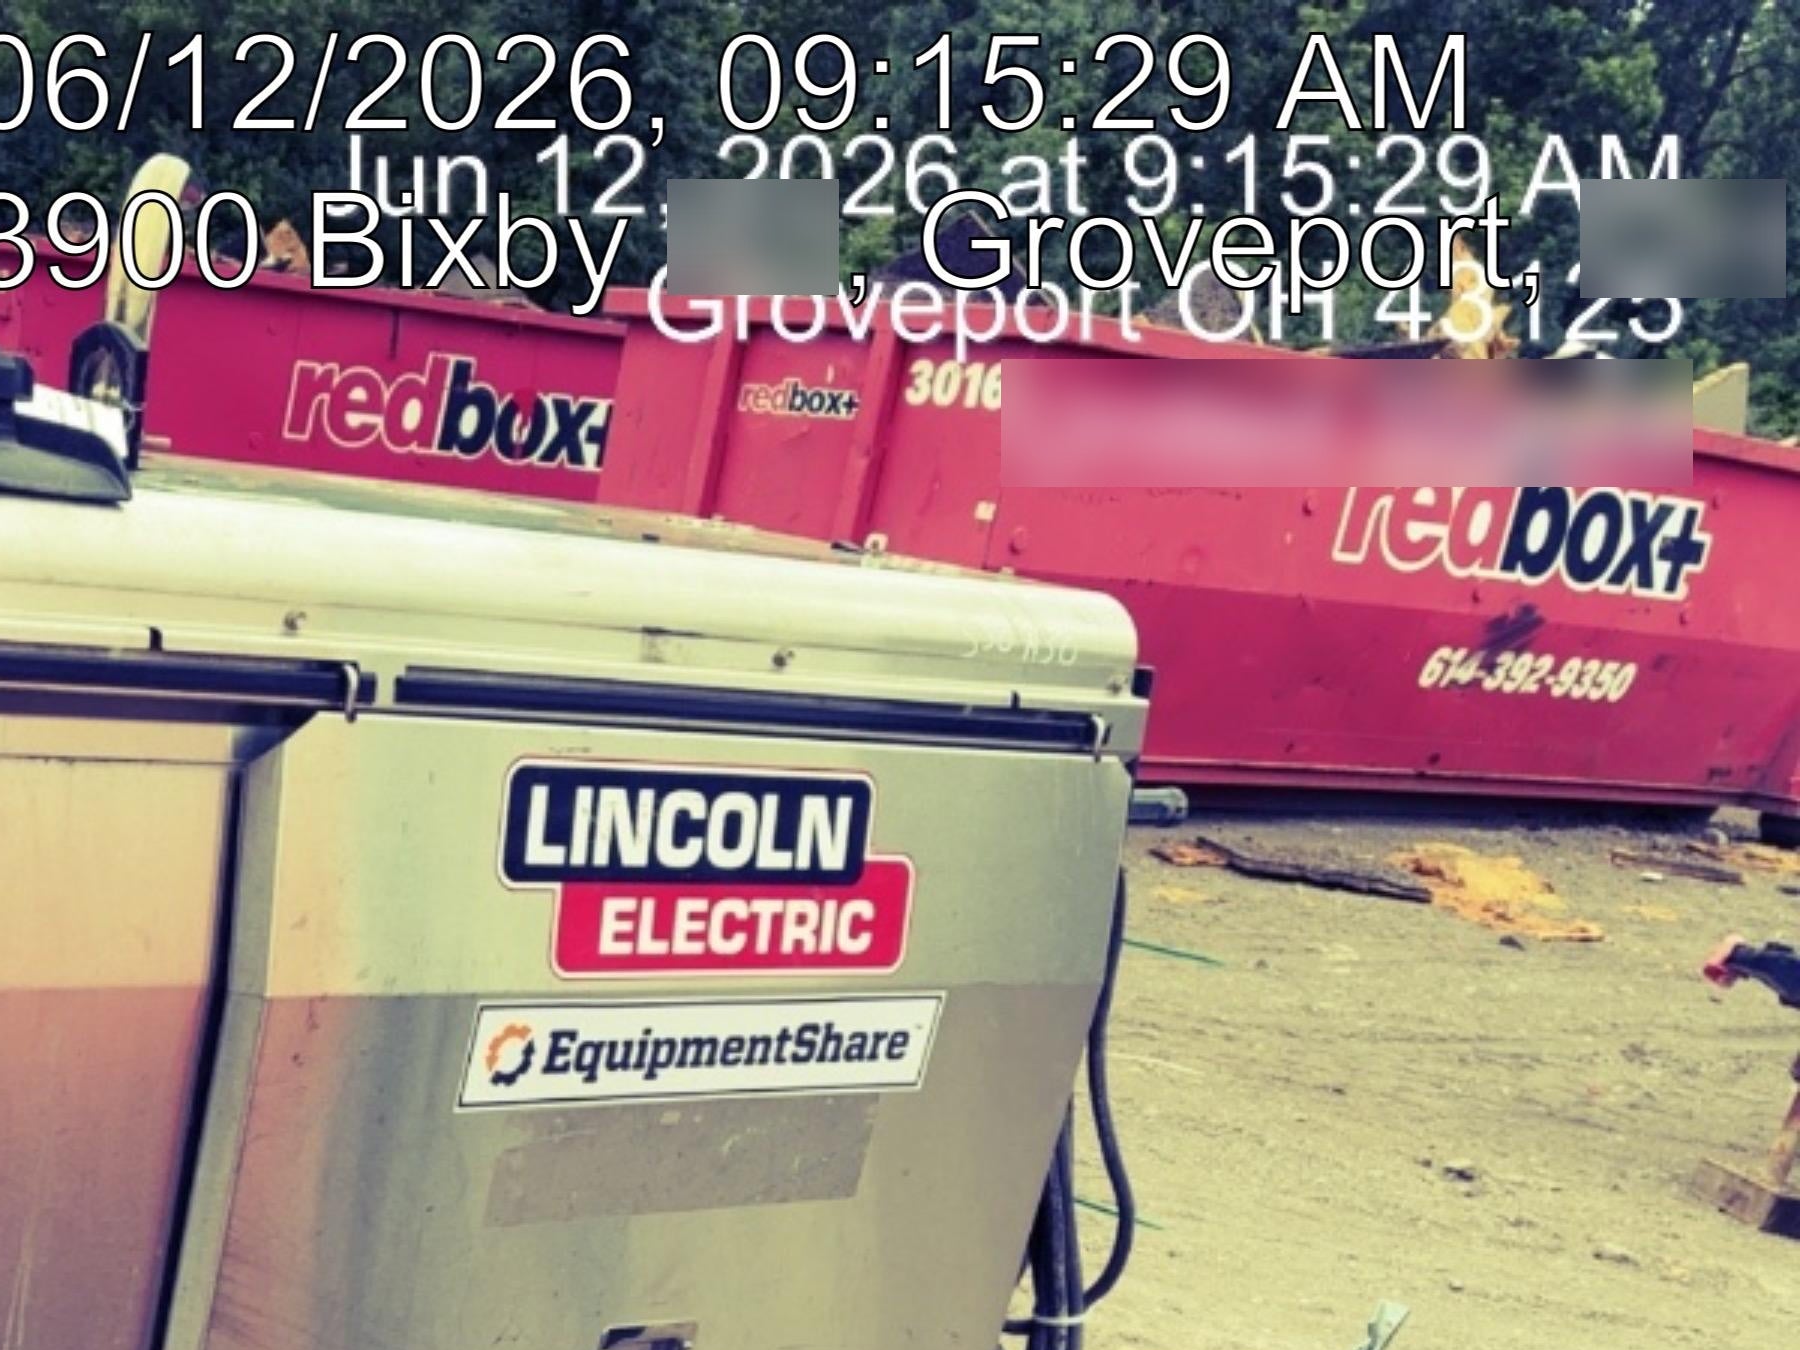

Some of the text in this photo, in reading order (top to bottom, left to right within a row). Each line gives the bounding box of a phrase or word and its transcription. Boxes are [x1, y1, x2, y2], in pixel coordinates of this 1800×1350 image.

[738, 378, 860, 420] redbox+
[1331, 486, 1714, 601] redbox+
[1417, 646, 1639, 703] 614-392-9350
[523, 784, 853, 872] LINCOLN
[598, 896, 876, 956] ELECTRIC
[540, 1022, 911, 1085] EquipmentShare
